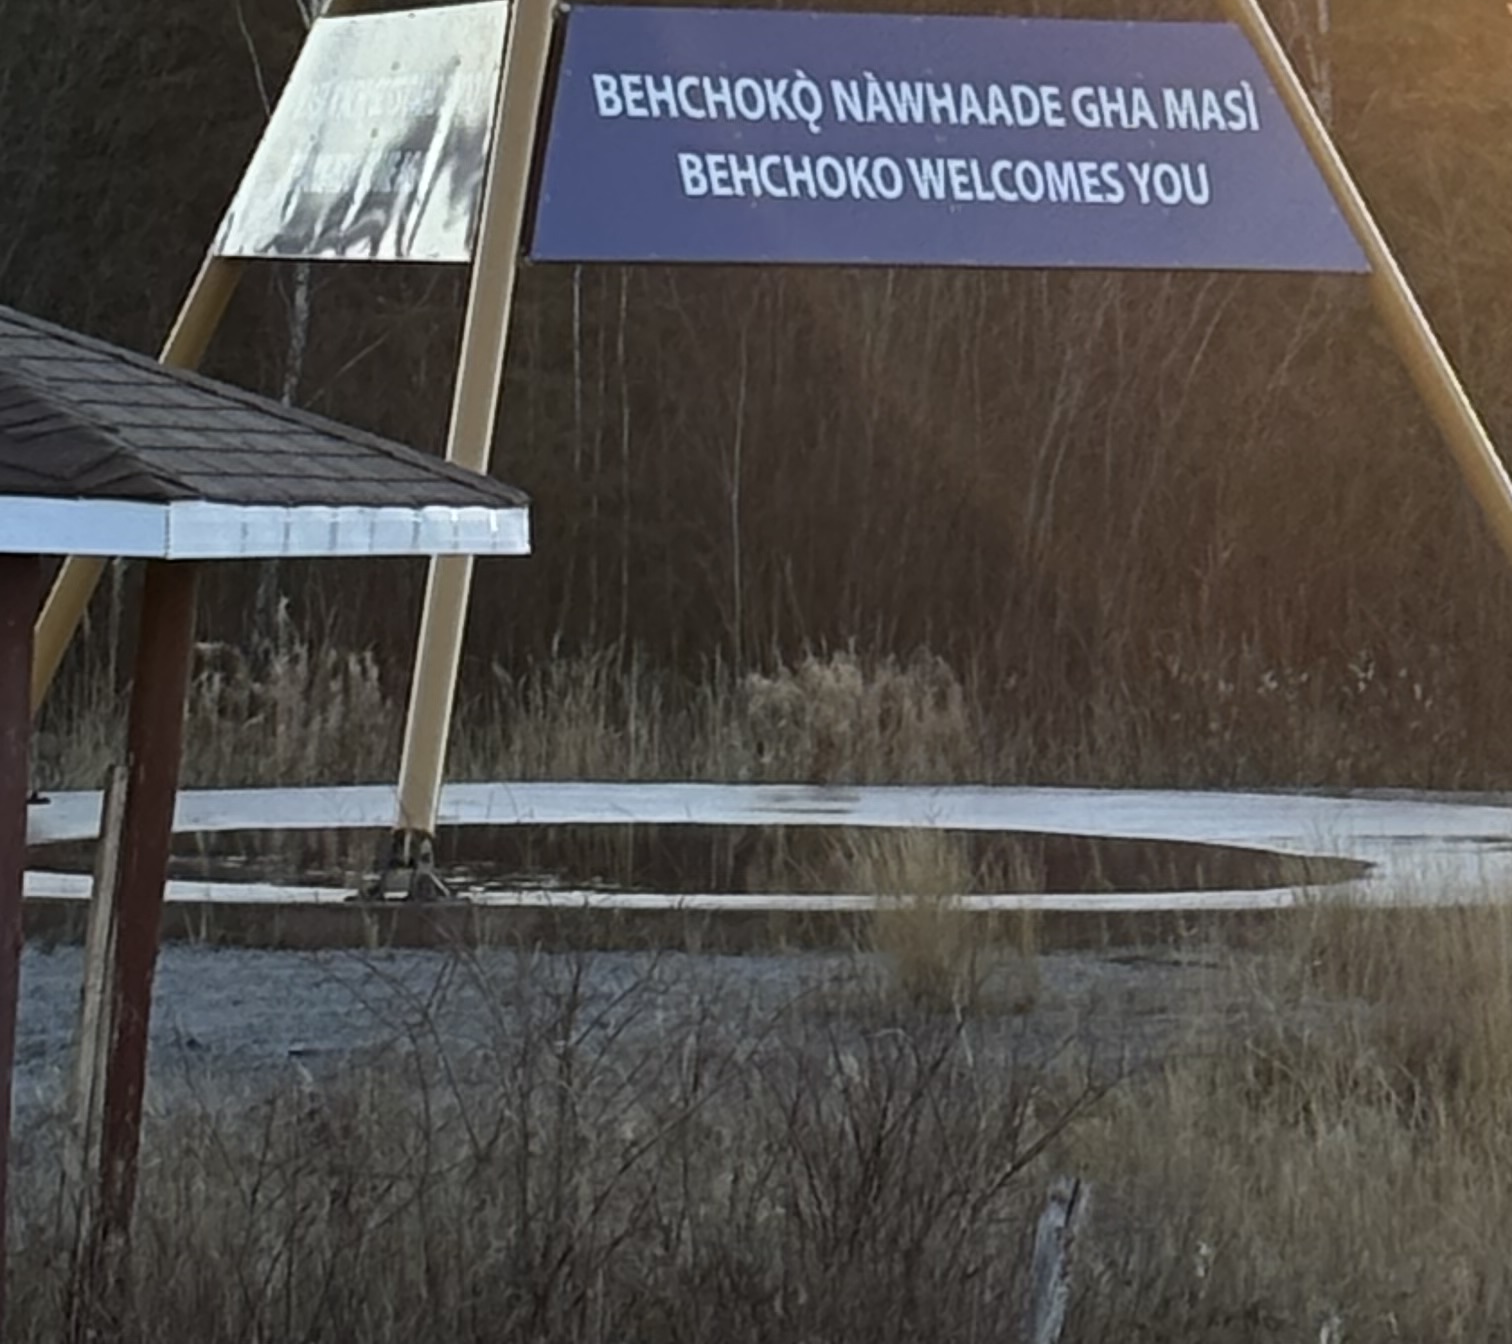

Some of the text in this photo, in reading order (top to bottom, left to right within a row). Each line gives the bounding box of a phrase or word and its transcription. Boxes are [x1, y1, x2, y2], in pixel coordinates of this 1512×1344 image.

[831, 72, 1065, 126] NÀWHAADE
[1072, 85, 1159, 130] GHA
[1163, 81, 1259, 131] MASÌ
[679, 152, 1210, 204] BEHCHOKO WELCOMES YOU
